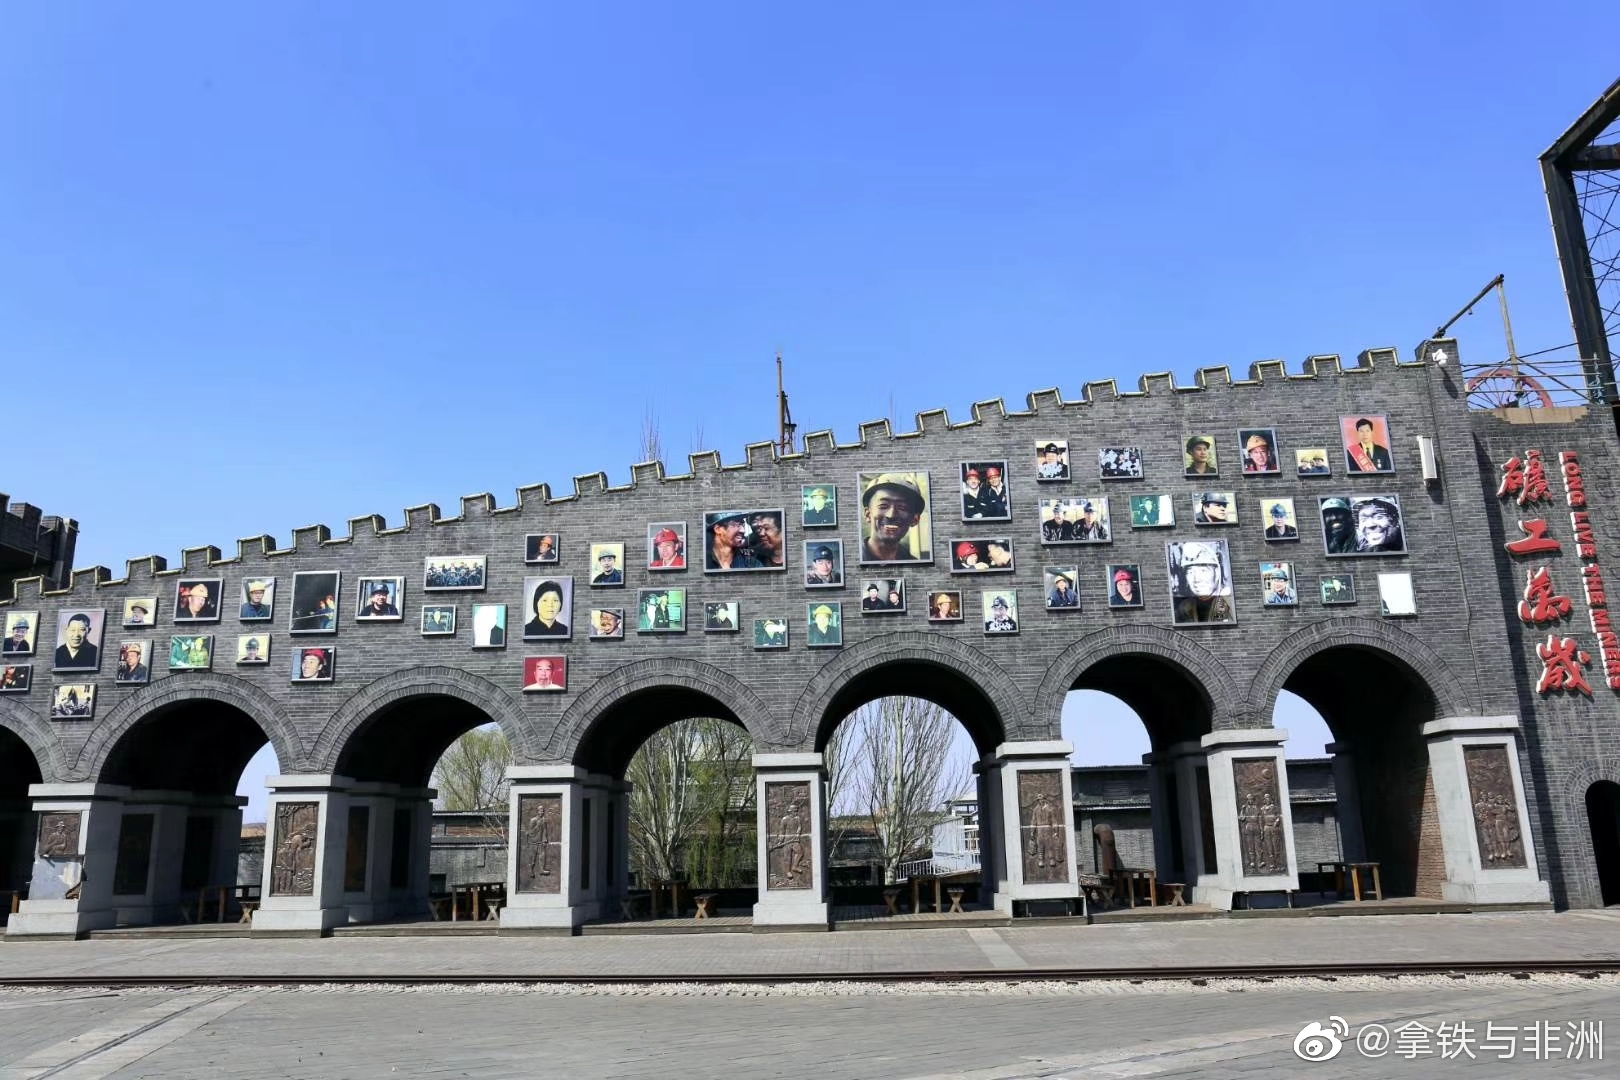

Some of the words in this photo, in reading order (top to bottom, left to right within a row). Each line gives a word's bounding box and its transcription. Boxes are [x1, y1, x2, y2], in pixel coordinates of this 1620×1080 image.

[1559, 450, 1587, 507] LONG
[1570, 511, 1598, 557] LIVE
[1581, 563, 1607, 606] THE
